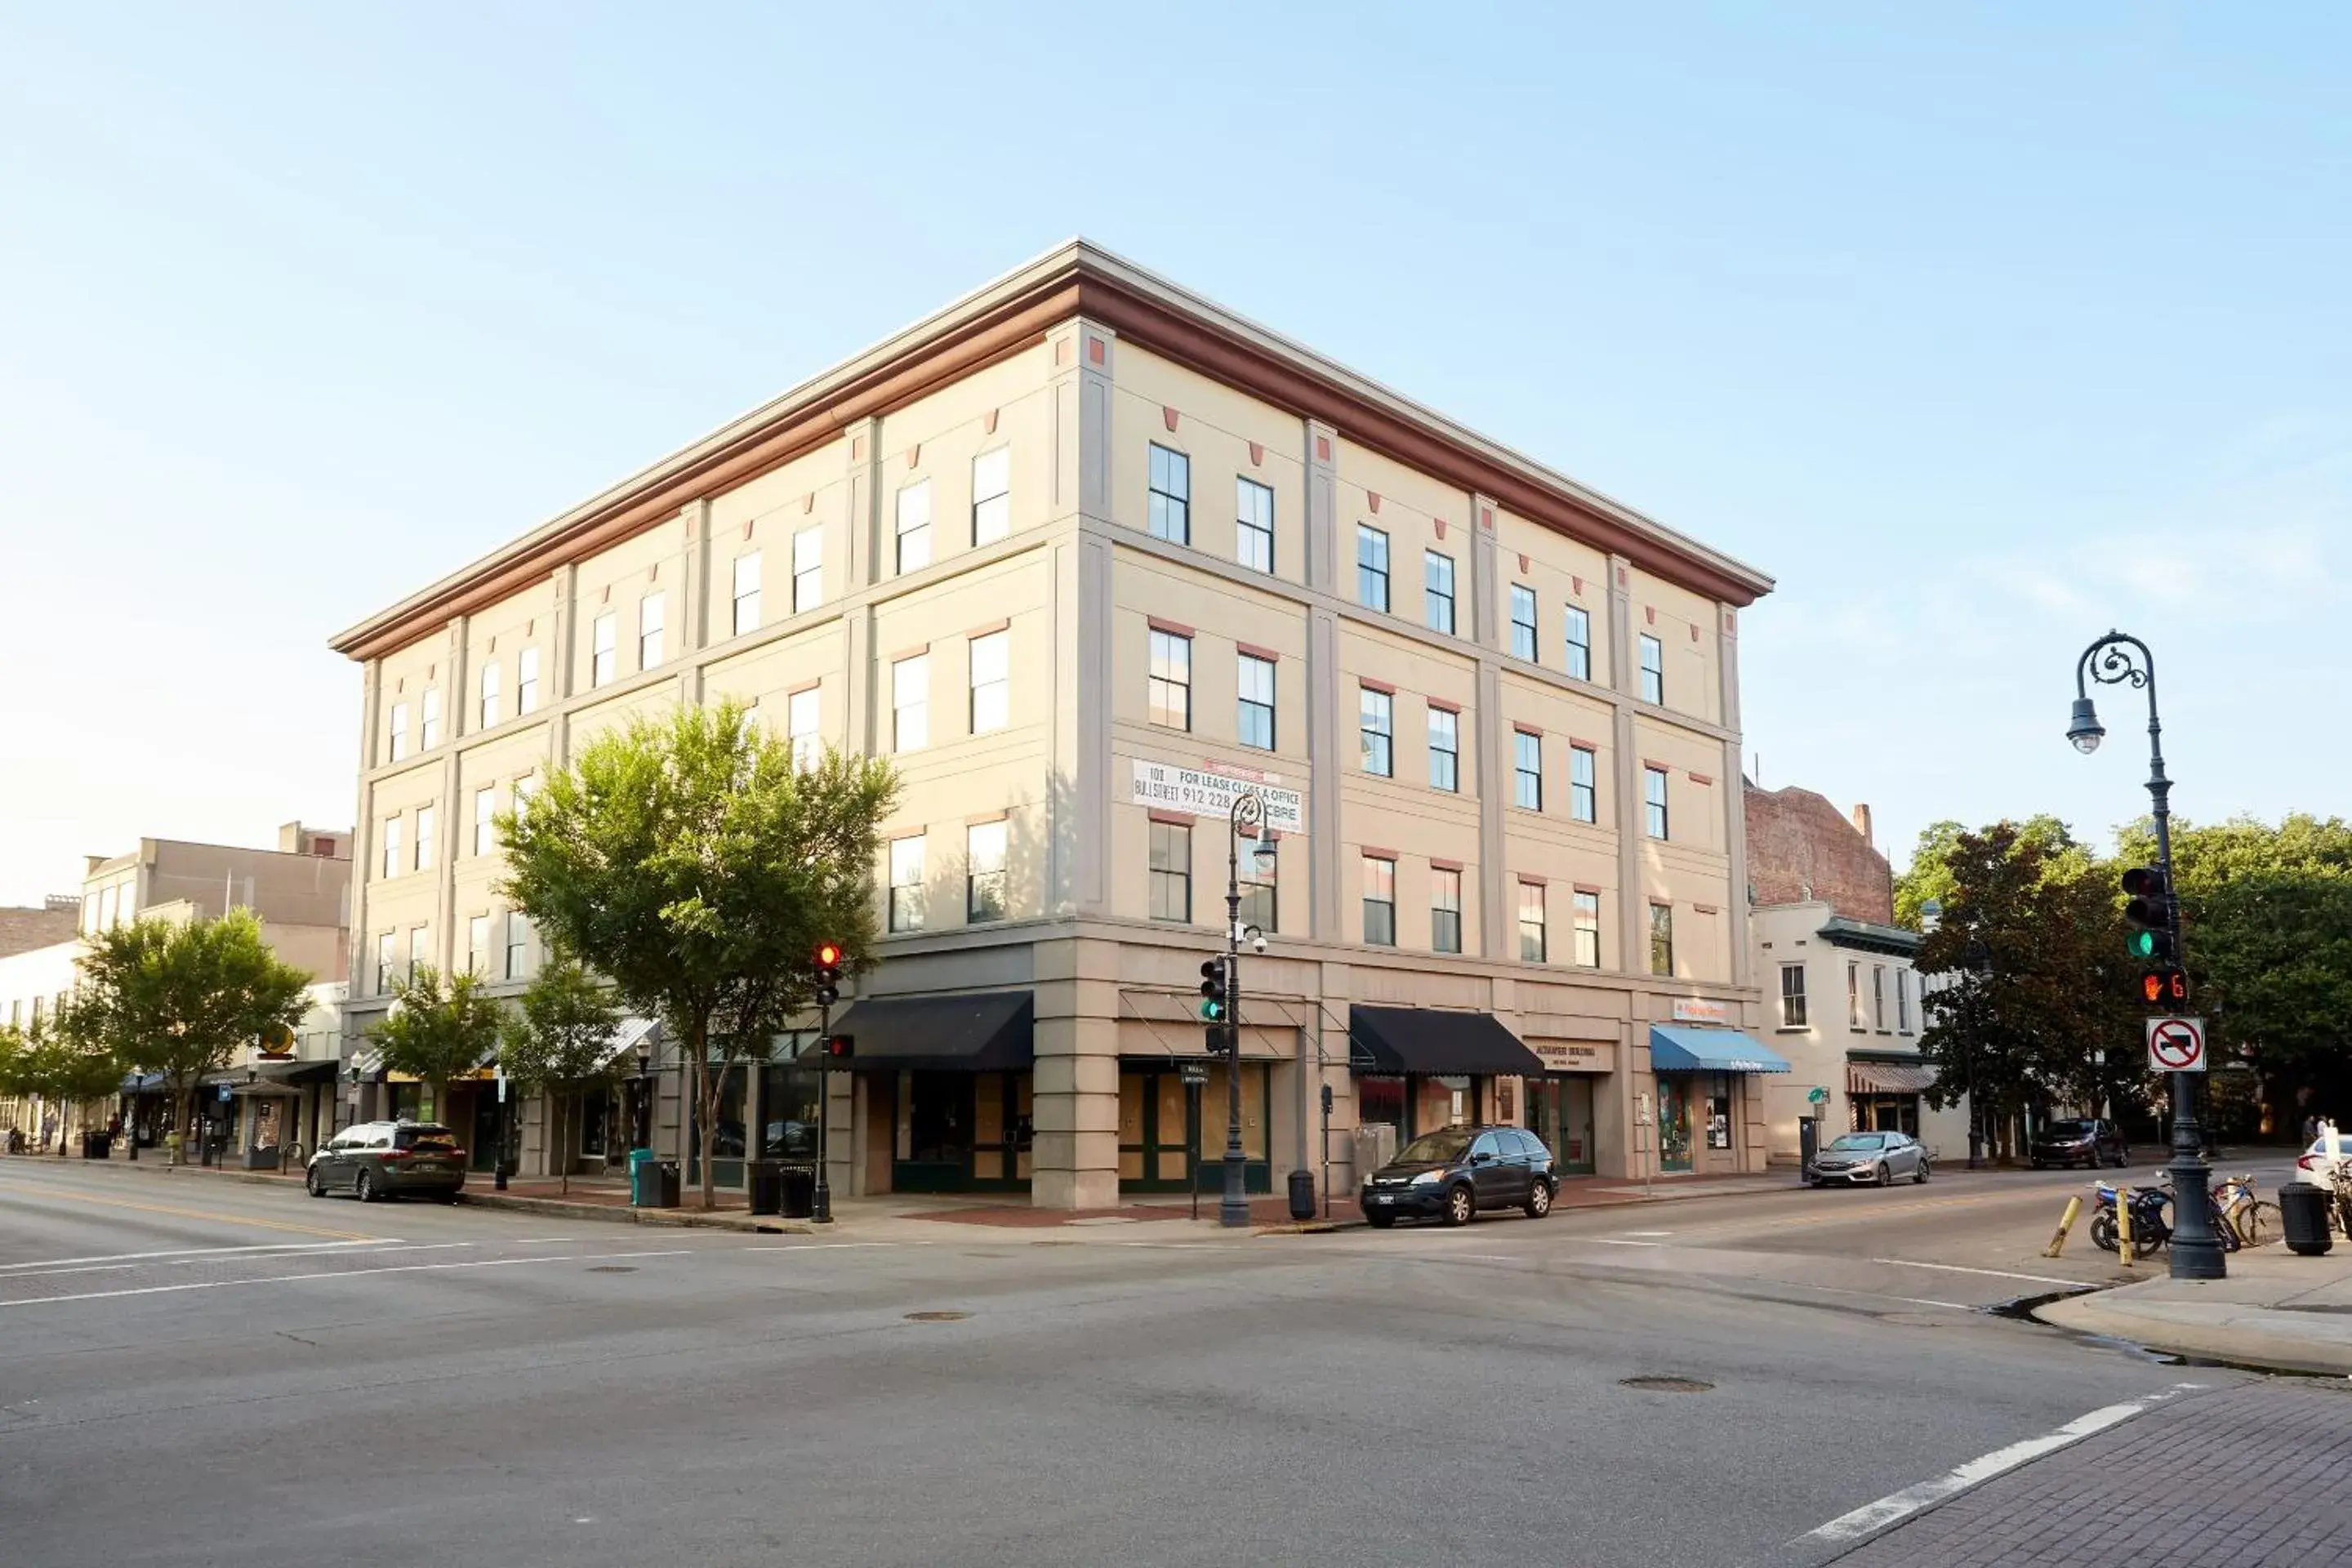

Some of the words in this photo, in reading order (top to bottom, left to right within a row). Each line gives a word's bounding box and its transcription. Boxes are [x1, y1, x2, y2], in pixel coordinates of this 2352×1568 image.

[1150, 768, 1165, 782] 101
[1180, 771, 1199, 784] FOR
[1202, 775, 1230, 791] LEASE
[1262, 788, 1269, 799] A
[1271, 790, 1298, 805] OFFICE
[1183, 786, 1205, 804] 912
[1208, 792, 1230, 808] 228
[1266, 804, 1297, 821] CBRE
[2172, 974, 2184, 998] 6
